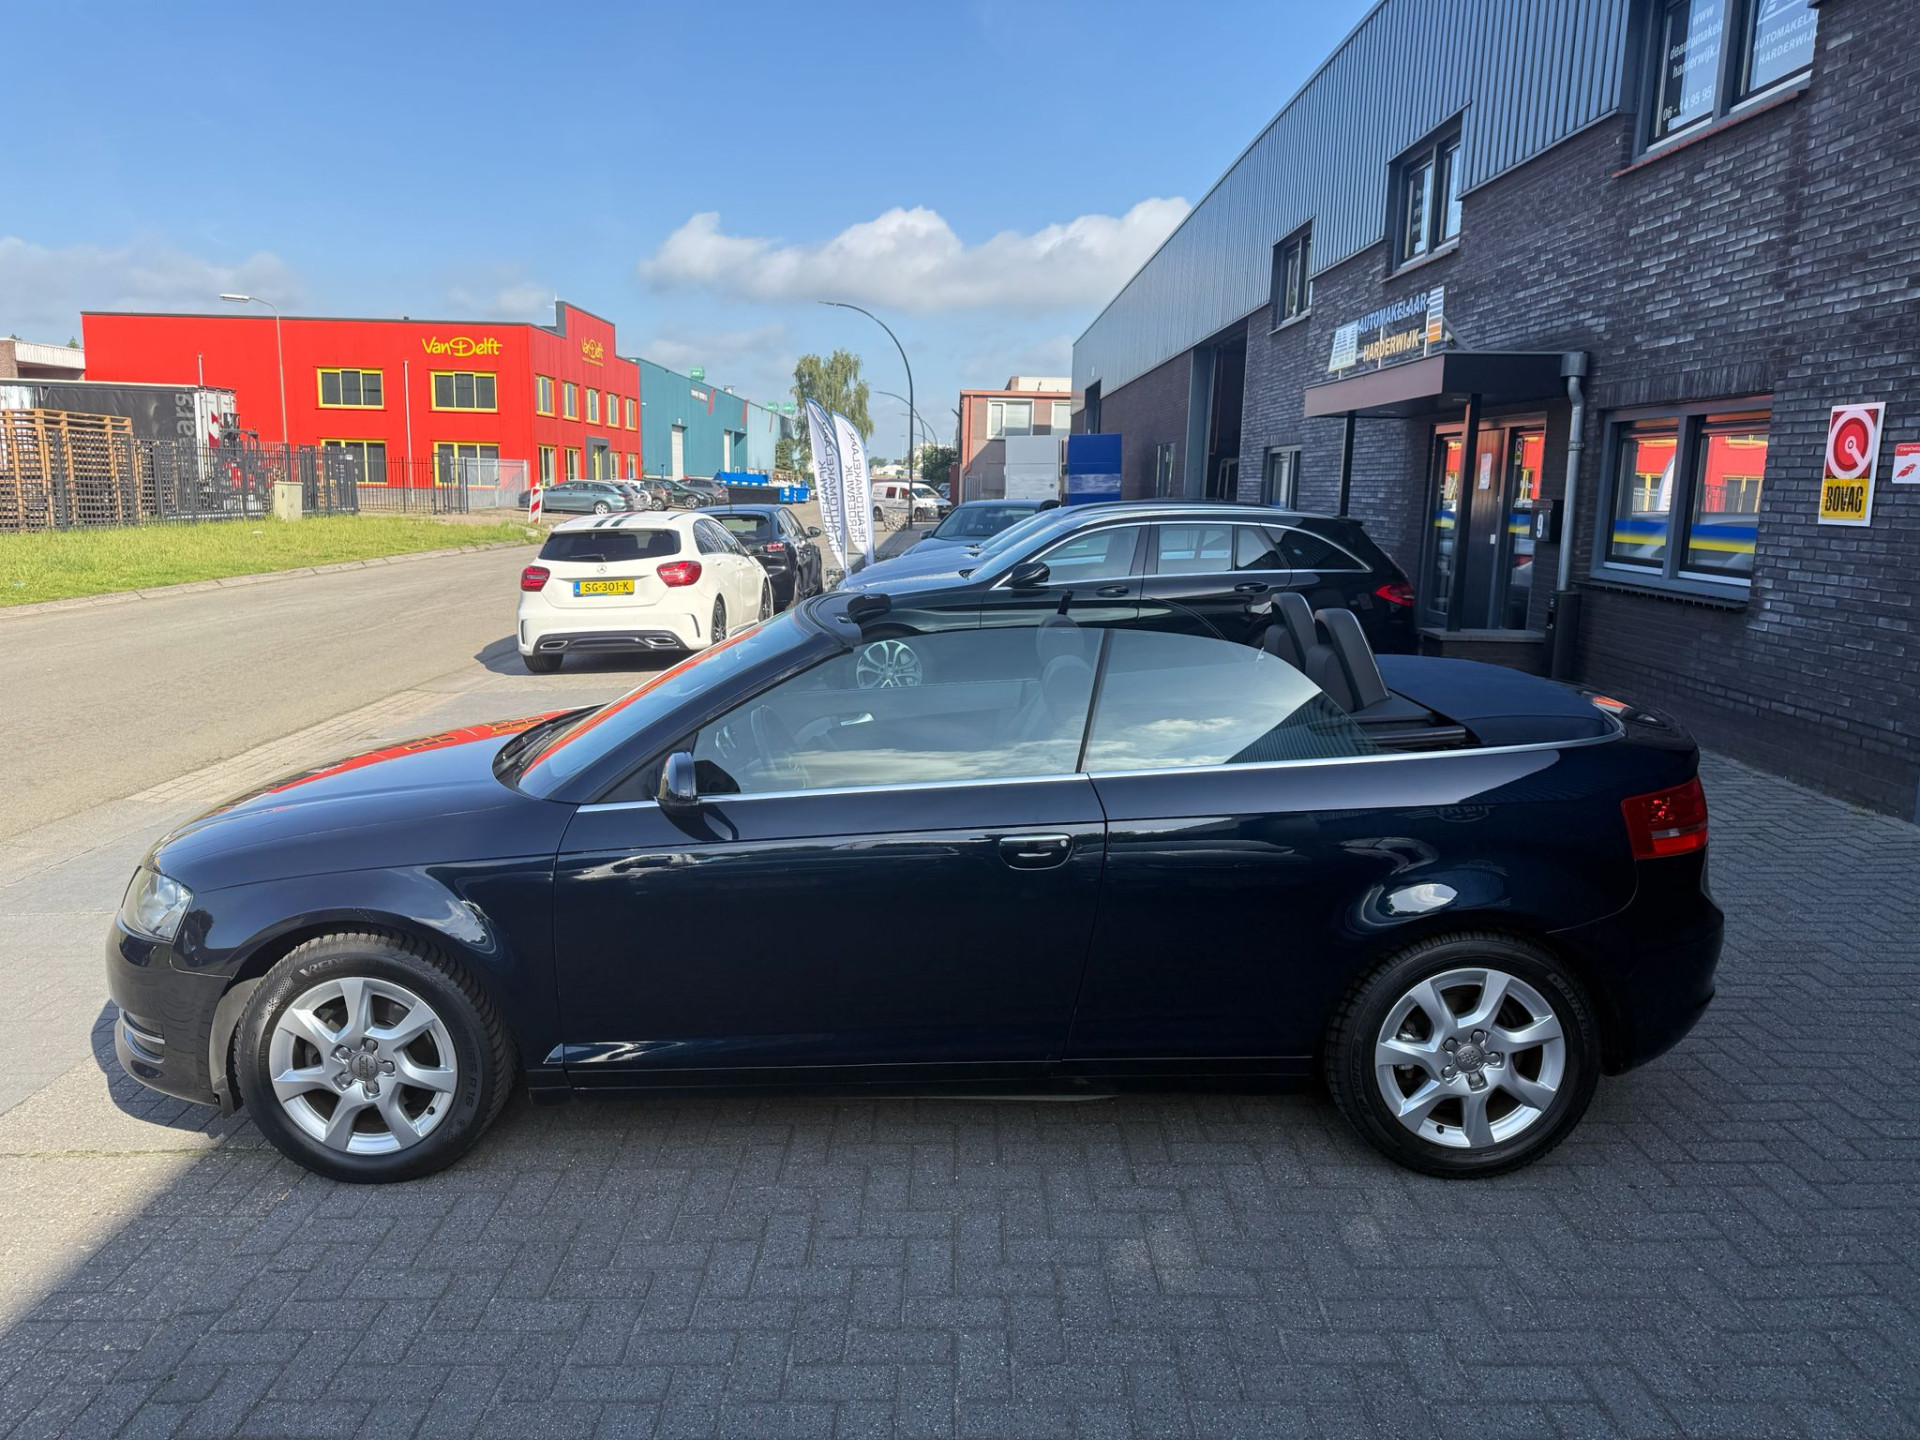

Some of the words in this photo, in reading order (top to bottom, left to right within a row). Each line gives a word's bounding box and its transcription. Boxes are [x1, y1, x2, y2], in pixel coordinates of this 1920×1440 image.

[1670, 18, 1722, 60] deautomakel
[1663, 106, 1672, 120] 06
[1359, 292, 1427, 334] AUTOMAKELAAR
[1363, 328, 1419, 361] HARDERWIJK
[1825, 486, 1863, 513] BOVAG
[1536, 513, 1544, 538] 9
[585, 582, 629, 593] SG-301-K
